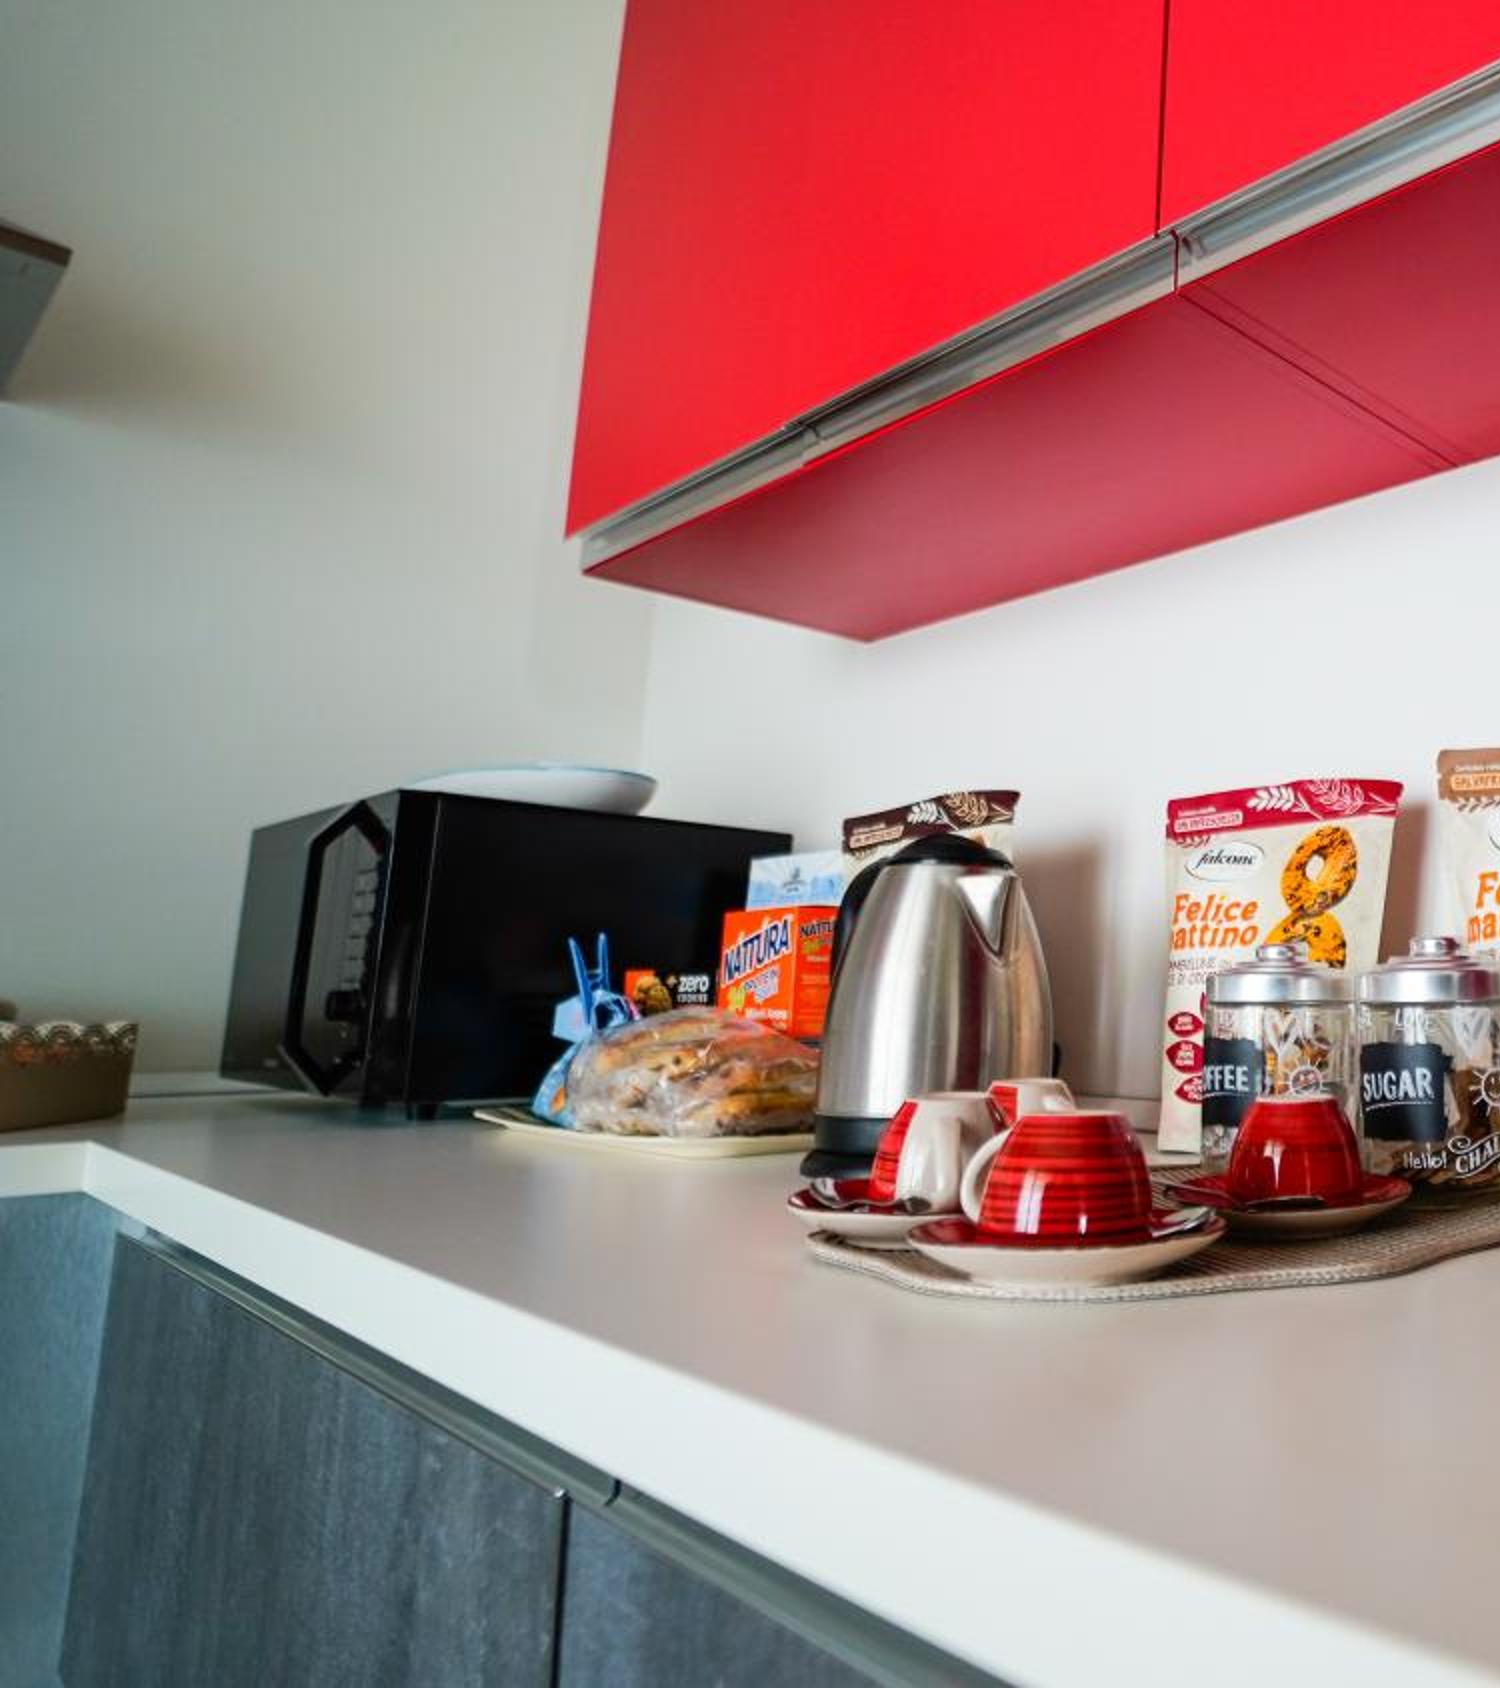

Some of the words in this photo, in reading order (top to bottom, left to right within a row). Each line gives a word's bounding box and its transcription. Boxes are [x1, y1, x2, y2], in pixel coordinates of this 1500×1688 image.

[1172, 893, 1258, 925] Felice
[724, 919, 790, 982] NATTURA
[1362, 1066, 1435, 1102] SUGAR
